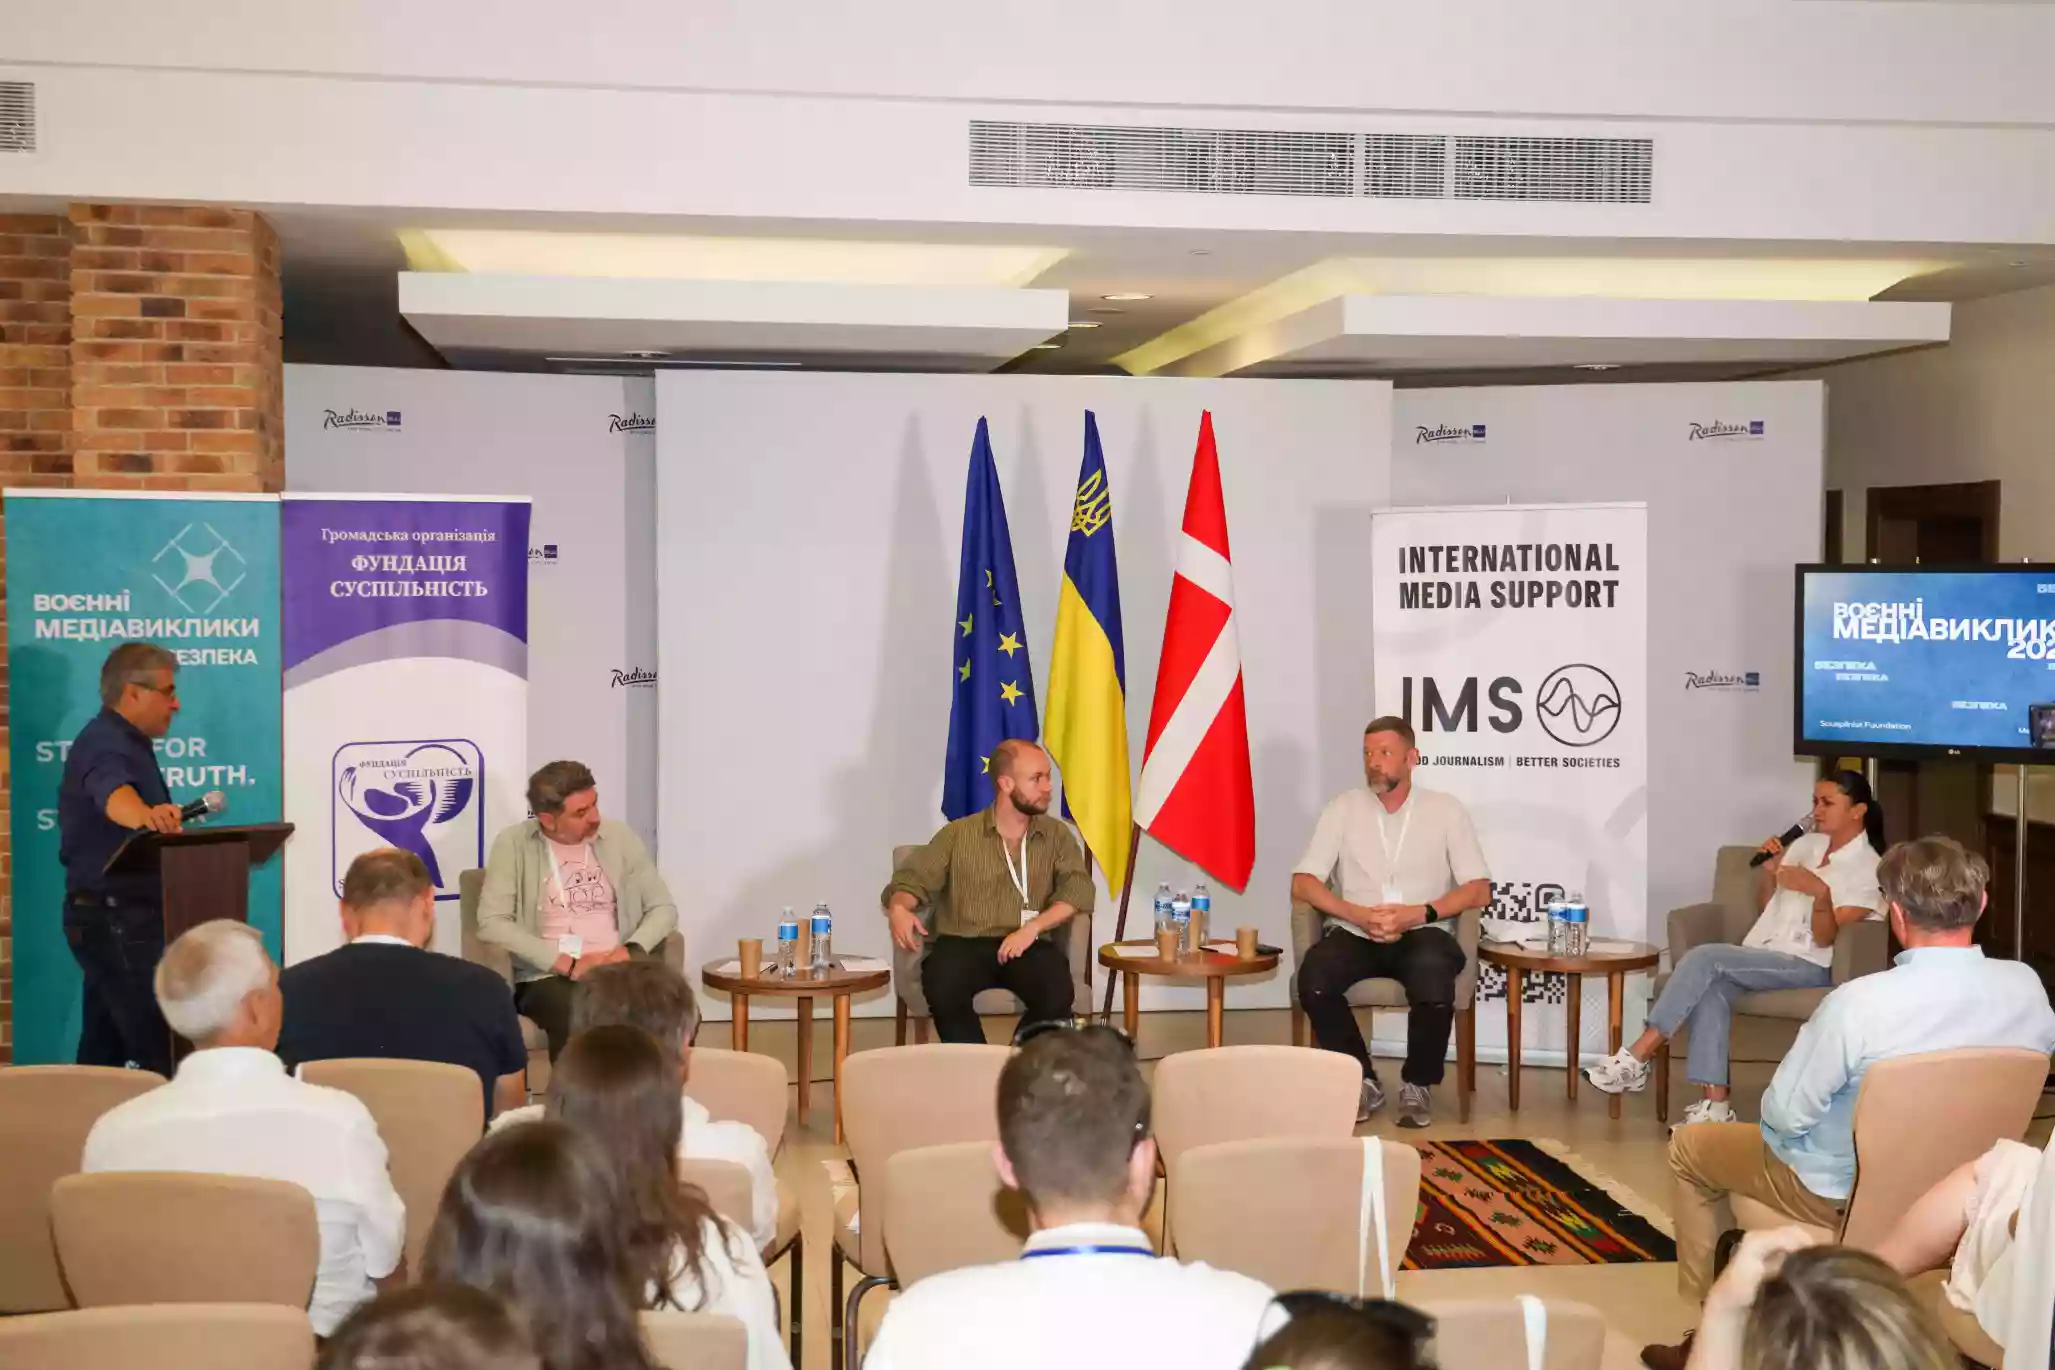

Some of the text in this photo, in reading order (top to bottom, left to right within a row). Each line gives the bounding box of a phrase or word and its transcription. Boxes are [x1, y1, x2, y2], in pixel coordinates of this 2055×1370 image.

[323, 407, 386, 430] Radisson
[608, 411, 656, 433] Radisso
[1415, 423, 1472, 444] Radisson
[1689, 419, 1748, 441] Radisson
[321, 528, 496, 544] Громадська організація
[351, 555, 467, 574] ФУНДАЦІЯ
[1398, 543, 1620, 574] INTERNATIONAL
[329, 580, 488, 598] СУСПІЛЬНІСТЬ
[1399, 580, 1620, 609] MEDIA SUPPORT
[35, 617, 260, 642] МЕДІАВИКЛИКИ
[1833, 617, 2055, 644] МЕДІАВИКЛИК
[168, 648, 259, 666] ЕЗПЕКА
[2006, 638, 2055, 660] 202
[611, 666, 657, 688] Radisso
[1684, 669, 1744, 690] Radisson
[1402, 676, 1523, 733] IMS
[1432, 755, 1505, 767] JOURNALISM
[1516, 756, 1559, 767] BETTER
[1562, 756, 1621, 768] SOCIETIES
[160, 765, 256, 788] RUTH.
